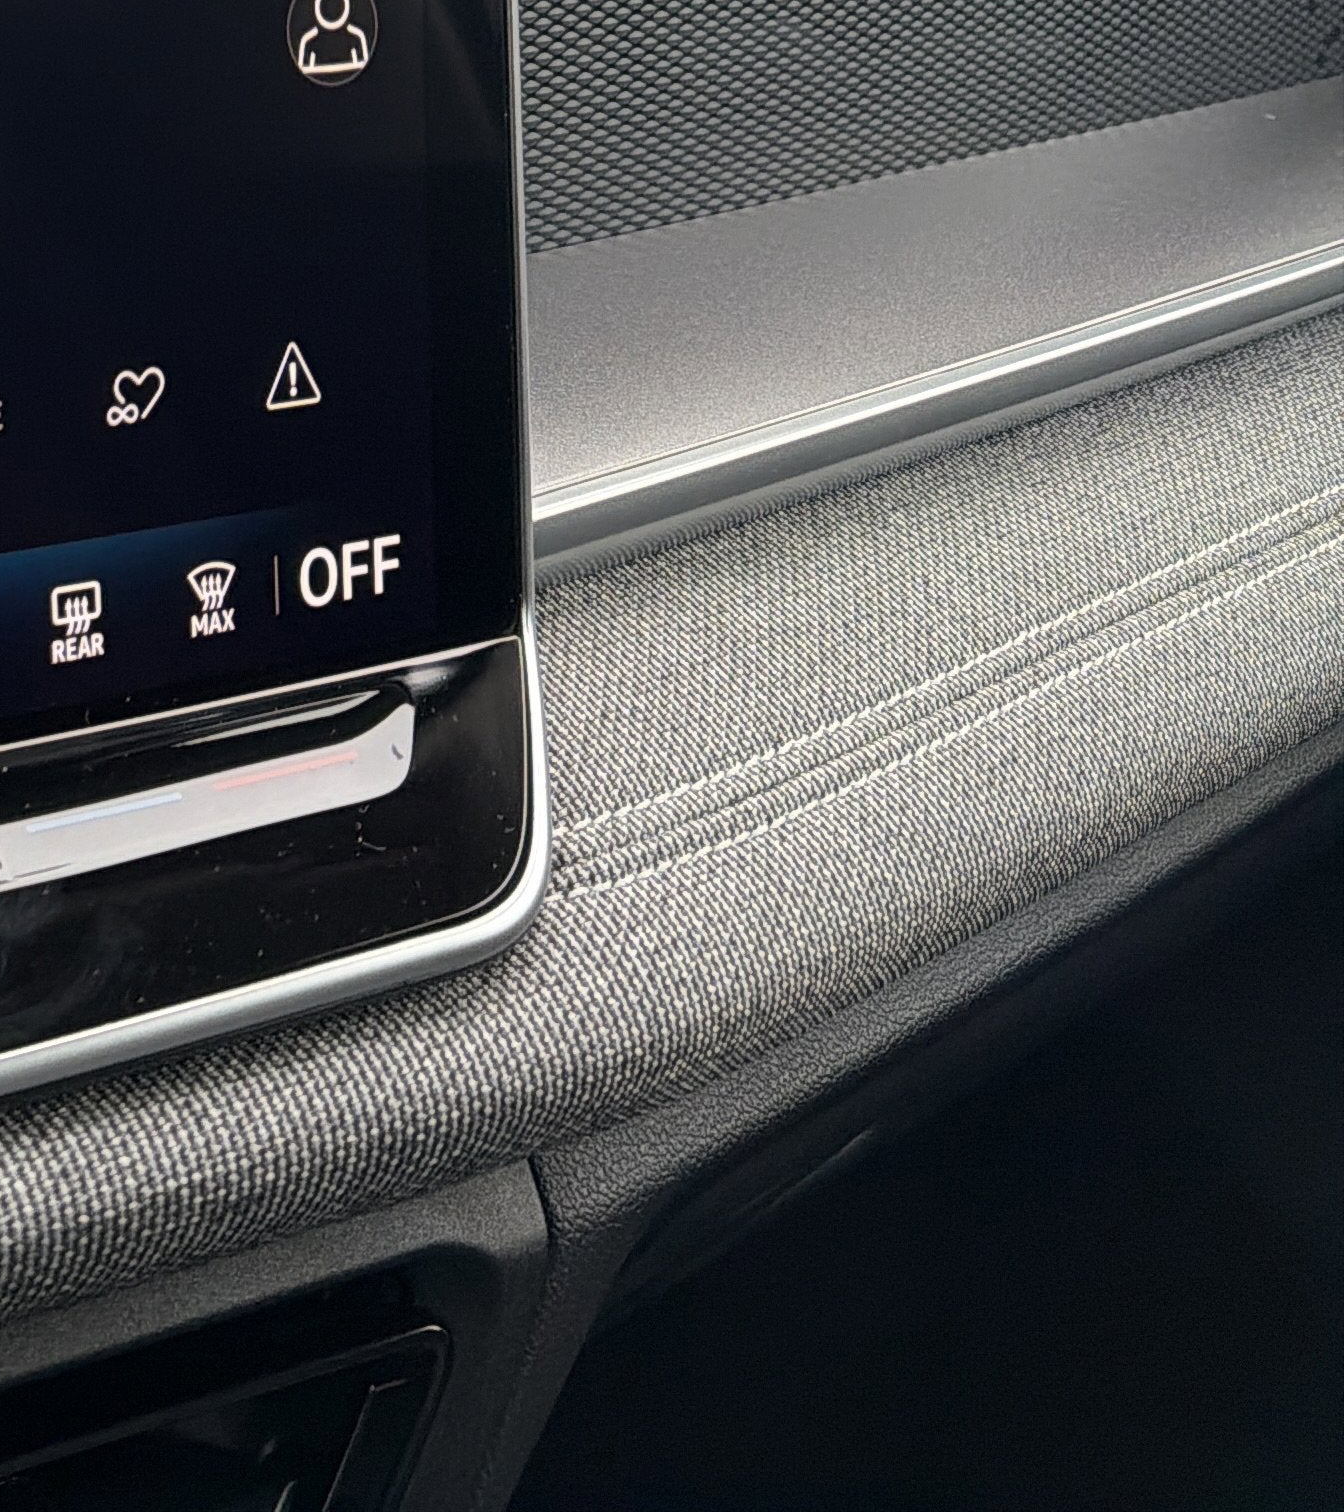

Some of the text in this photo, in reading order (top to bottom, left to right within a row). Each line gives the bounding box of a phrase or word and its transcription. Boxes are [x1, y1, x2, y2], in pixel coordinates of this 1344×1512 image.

[298, 532, 402, 608] OFF
[189, 608, 237, 639] MAX
[50, 633, 106, 665] REAR
